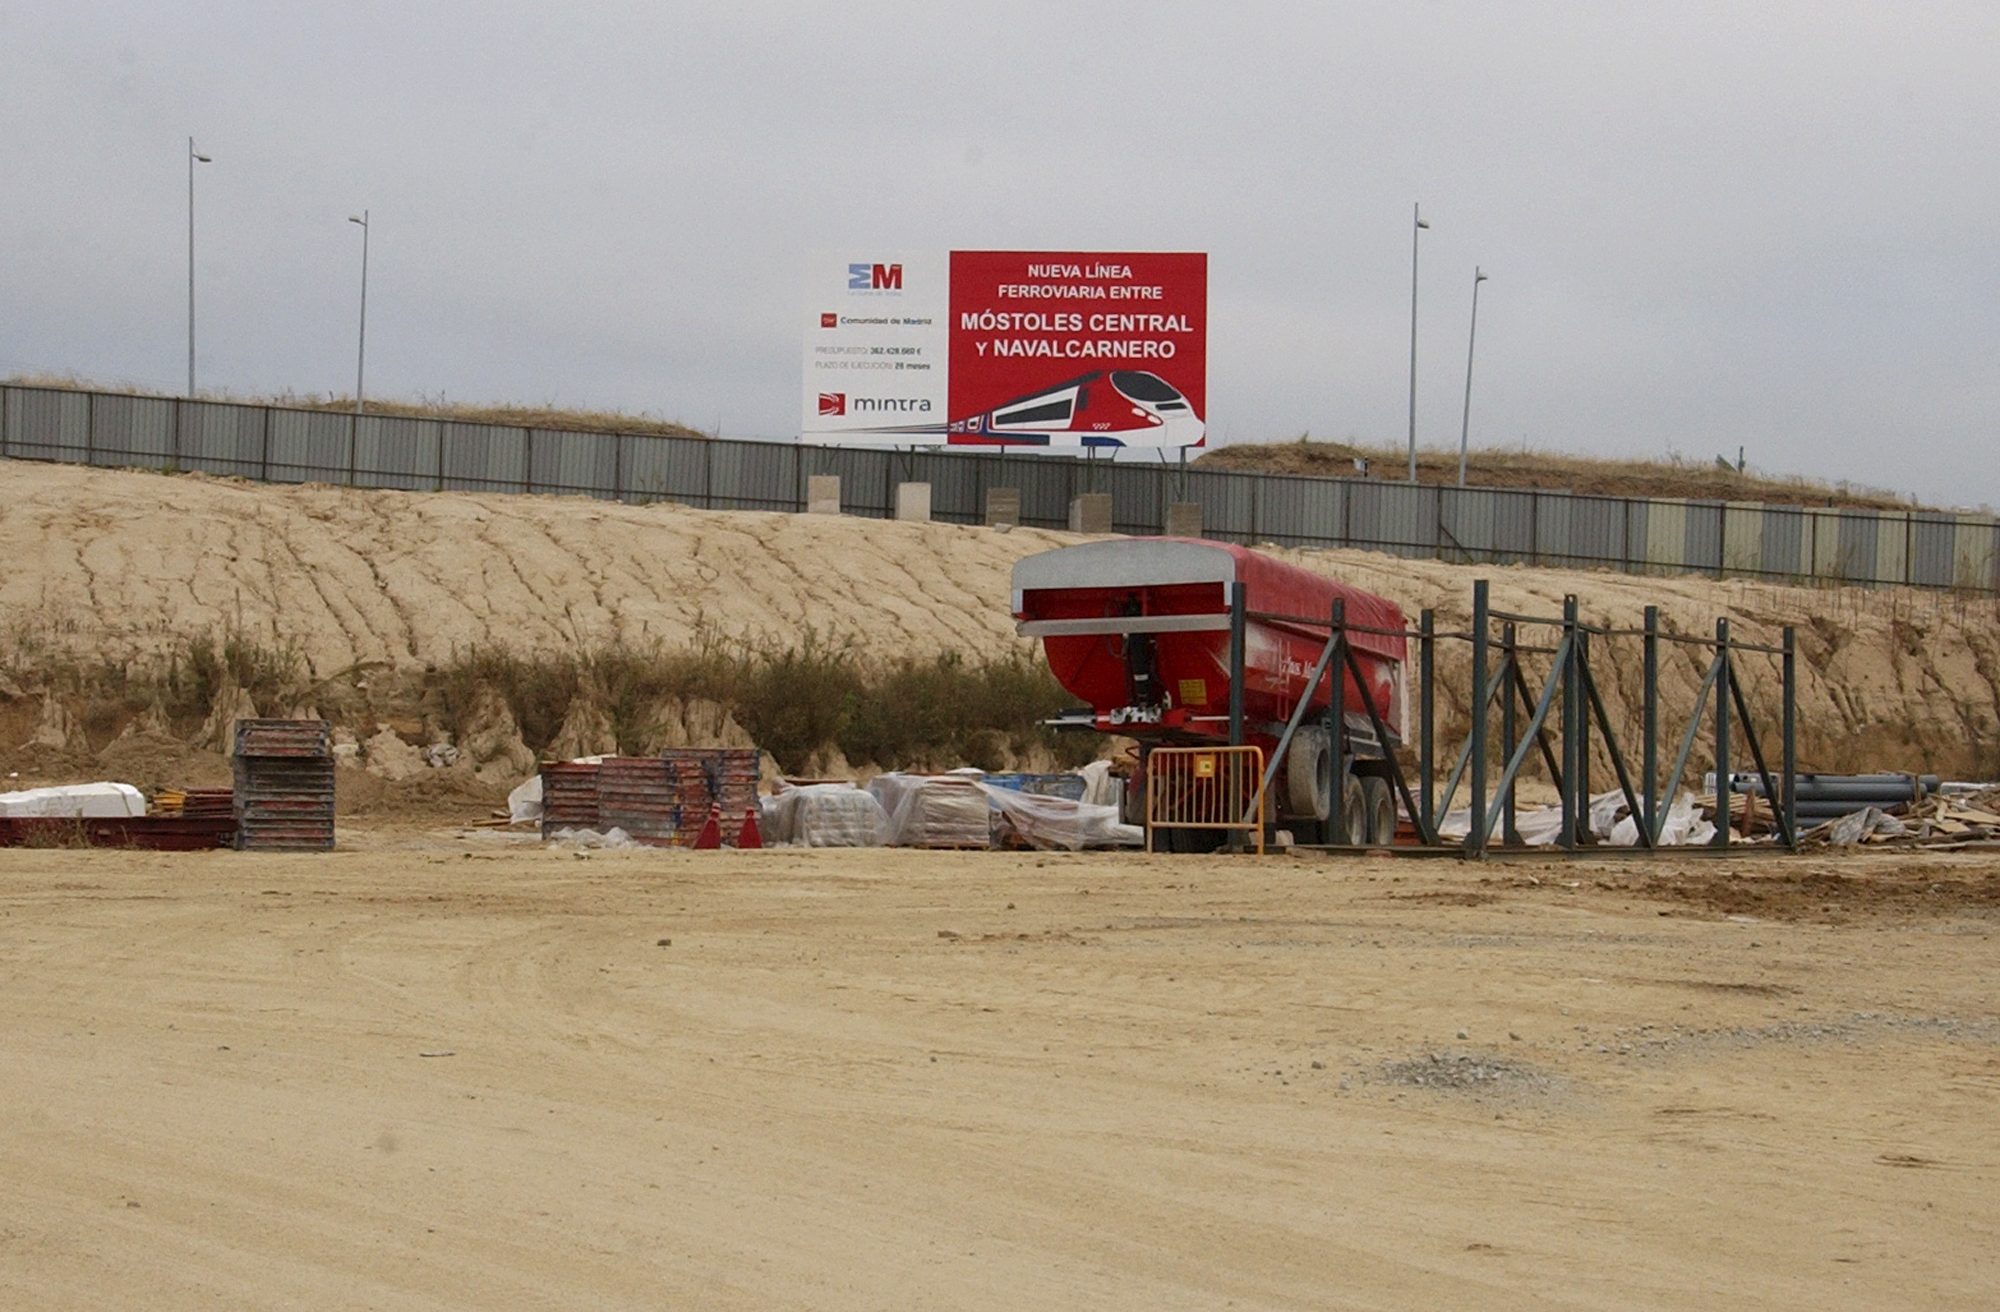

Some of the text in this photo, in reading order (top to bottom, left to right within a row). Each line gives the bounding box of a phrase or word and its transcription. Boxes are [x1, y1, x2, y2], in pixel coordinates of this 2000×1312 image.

[1028, 262, 1132, 279] NUEVA LÍNEA
[998, 284, 1163, 299] FERROVIARIA ENTRE
[840, 316, 889, 325] Comunidad
[890, 316, 901, 325] de
[903, 316, 932, 325] Madrid
[961, 308, 1194, 332] MÓSTOLES CENTRAL
[975, 339, 1176, 358] Y NAVALCARNERO
[854, 397, 932, 412] mintra
